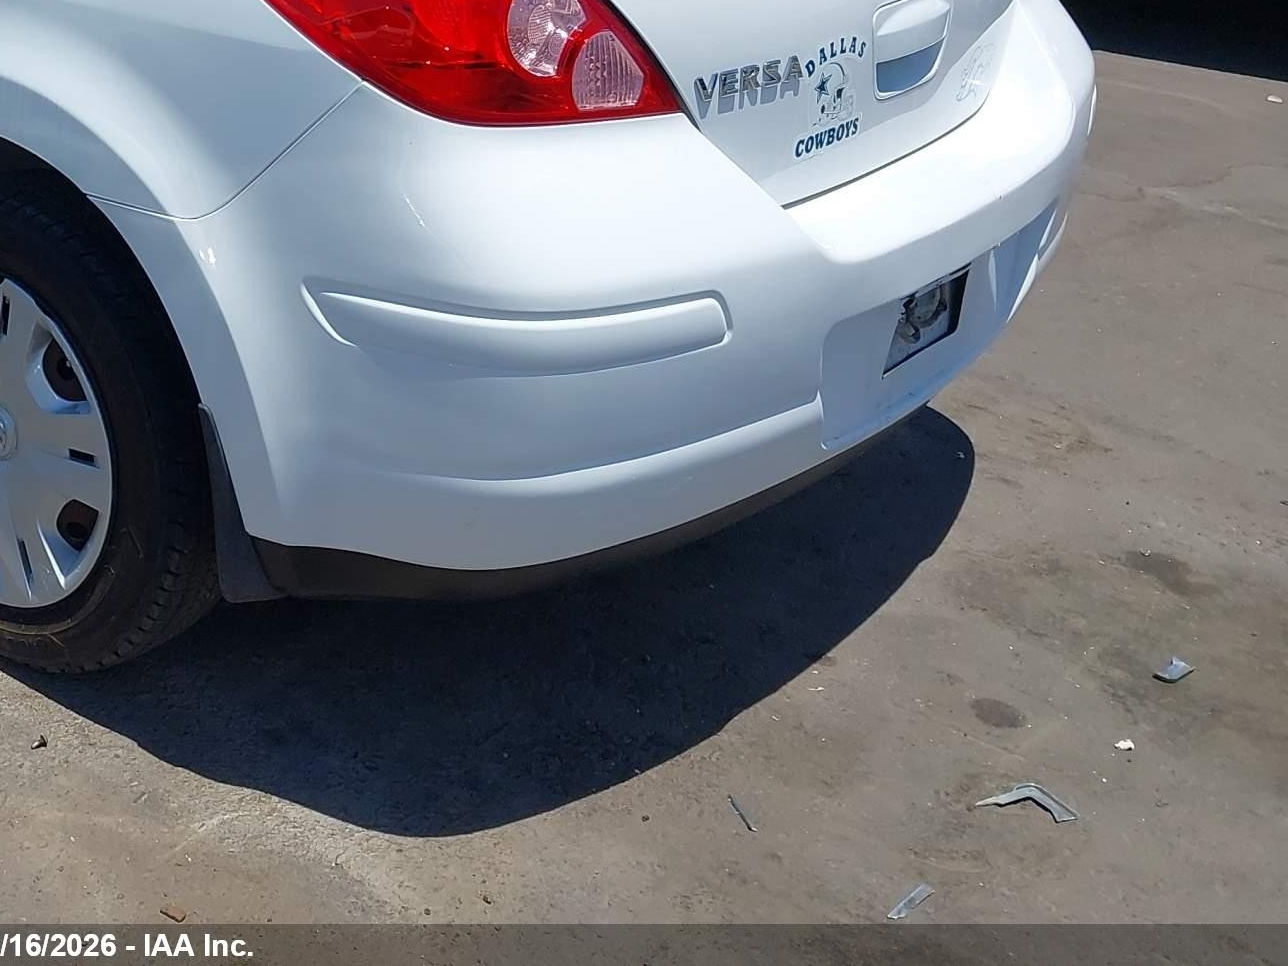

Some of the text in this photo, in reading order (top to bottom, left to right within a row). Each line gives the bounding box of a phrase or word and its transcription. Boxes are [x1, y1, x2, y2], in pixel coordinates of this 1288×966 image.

[805, 36, 867, 78] DALLAS
[694, 55, 805, 102] VERSA
[795, 117, 860, 159] COWBOYS
